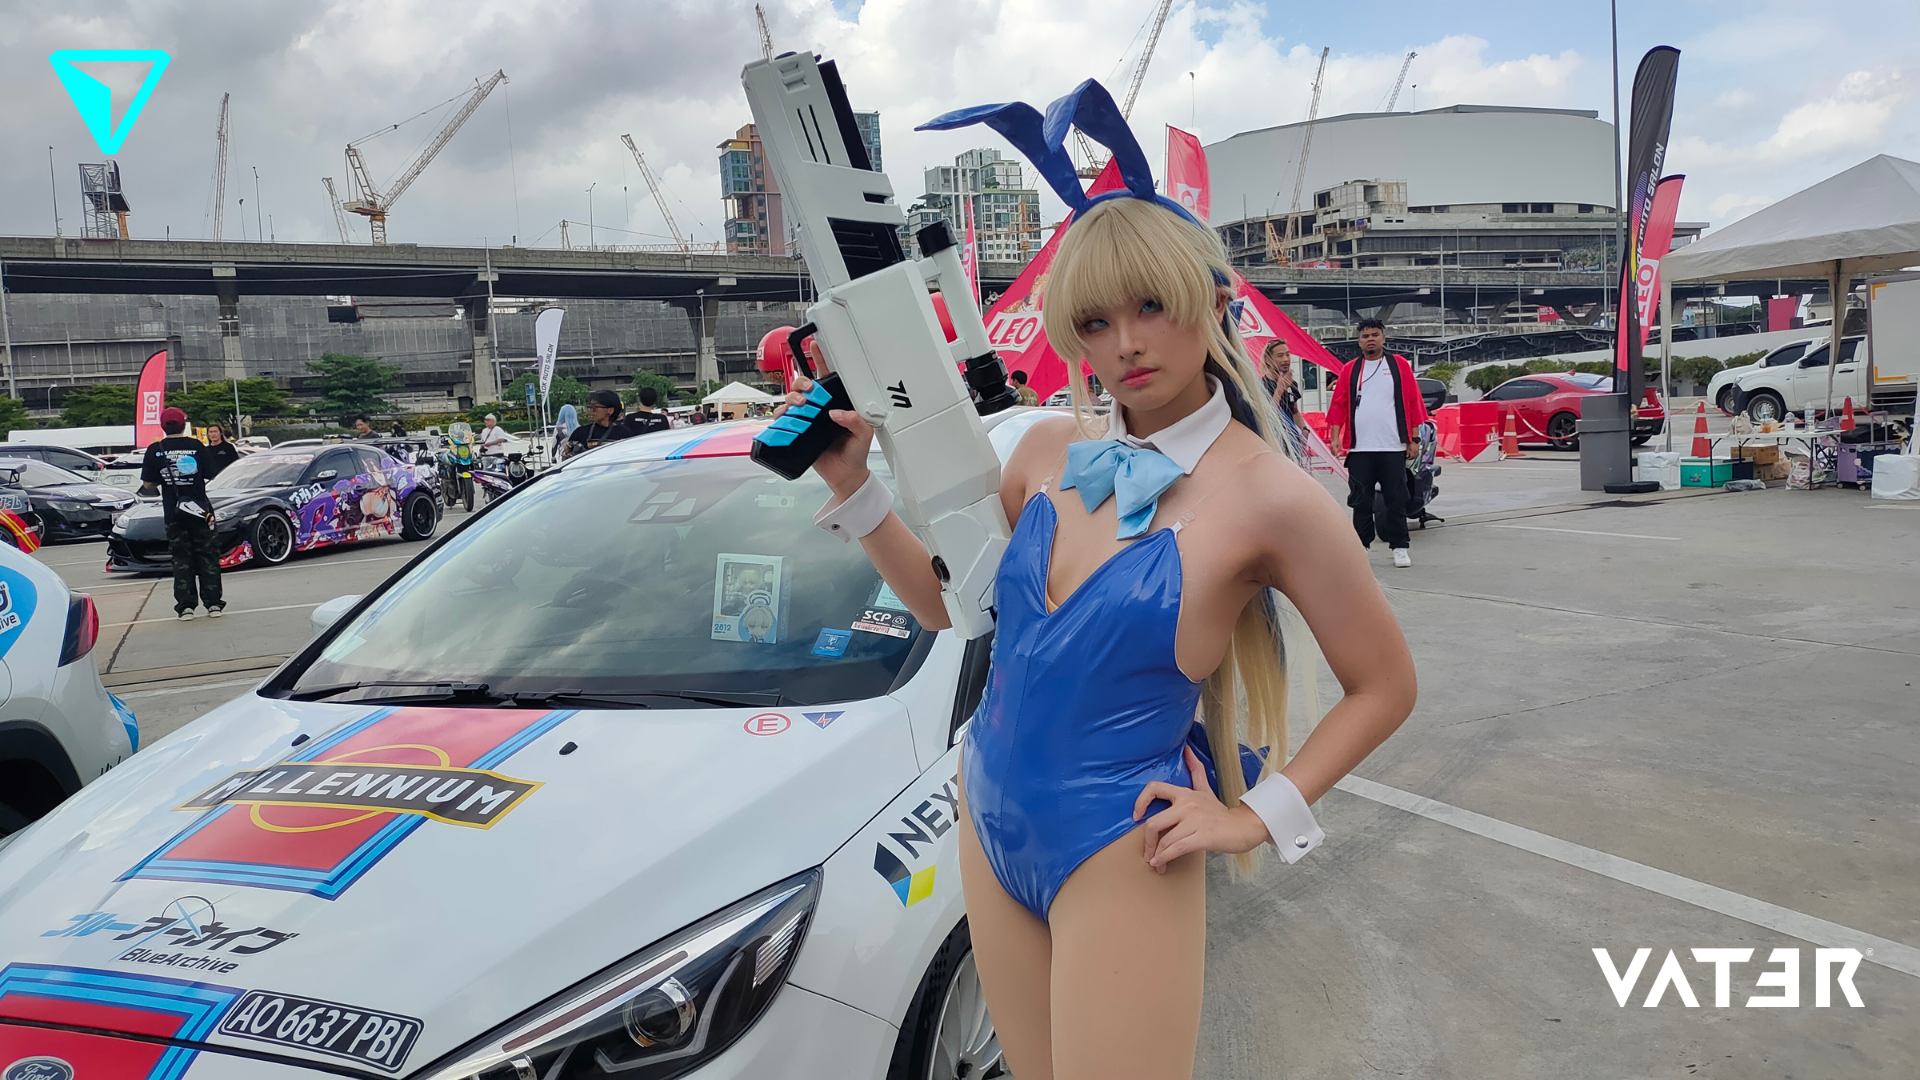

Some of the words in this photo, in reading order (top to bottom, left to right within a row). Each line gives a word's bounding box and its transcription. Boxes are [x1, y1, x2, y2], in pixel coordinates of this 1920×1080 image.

[1647, 142, 1665, 197] SALON
[987, 316, 1038, 345] LEO
[546, 343, 554, 364] SALON
[146, 394, 158, 421] LEO
[862, 610, 892, 622] SCP
[756, 717, 779, 732] E
[886, 774, 960, 860] NEX
[118, 948, 239, 974] BlueArchive
[227, 995, 285, 1034] AO
[276, 1004, 362, 1048] 6637
[346, 1016, 413, 1066] PBI
